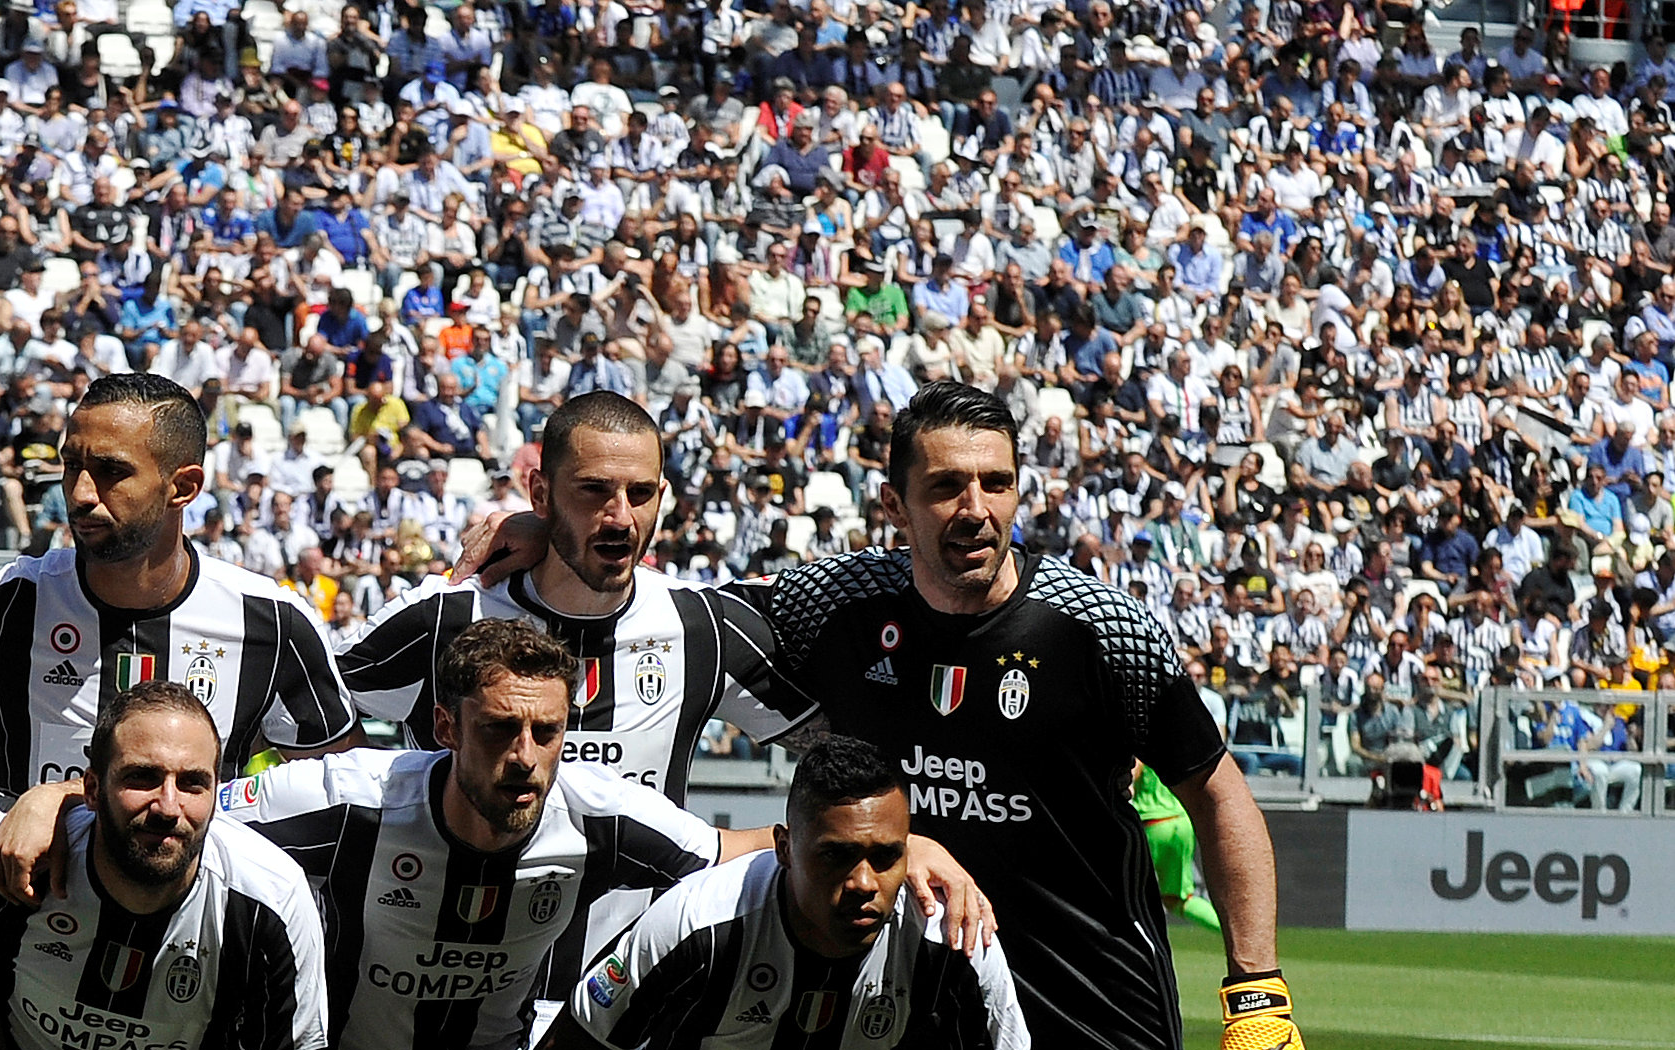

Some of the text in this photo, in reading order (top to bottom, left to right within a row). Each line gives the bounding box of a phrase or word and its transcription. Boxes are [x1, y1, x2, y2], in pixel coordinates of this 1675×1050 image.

[42, 673, 85, 687] adidas
[864, 670, 899, 686] adidas
[561, 740, 624, 766] eep
[900, 745, 987, 789] Jeep
[909, 783, 1033, 823] MPASS
[1430, 830, 1631, 921] Jeep
[377, 895, 422, 909] adidas
[34, 941, 74, 963] adidas
[415, 942, 509, 974] Jeep
[58, 1003, 152, 1040] Jeep
[735, 1013, 773, 1025] adidas
